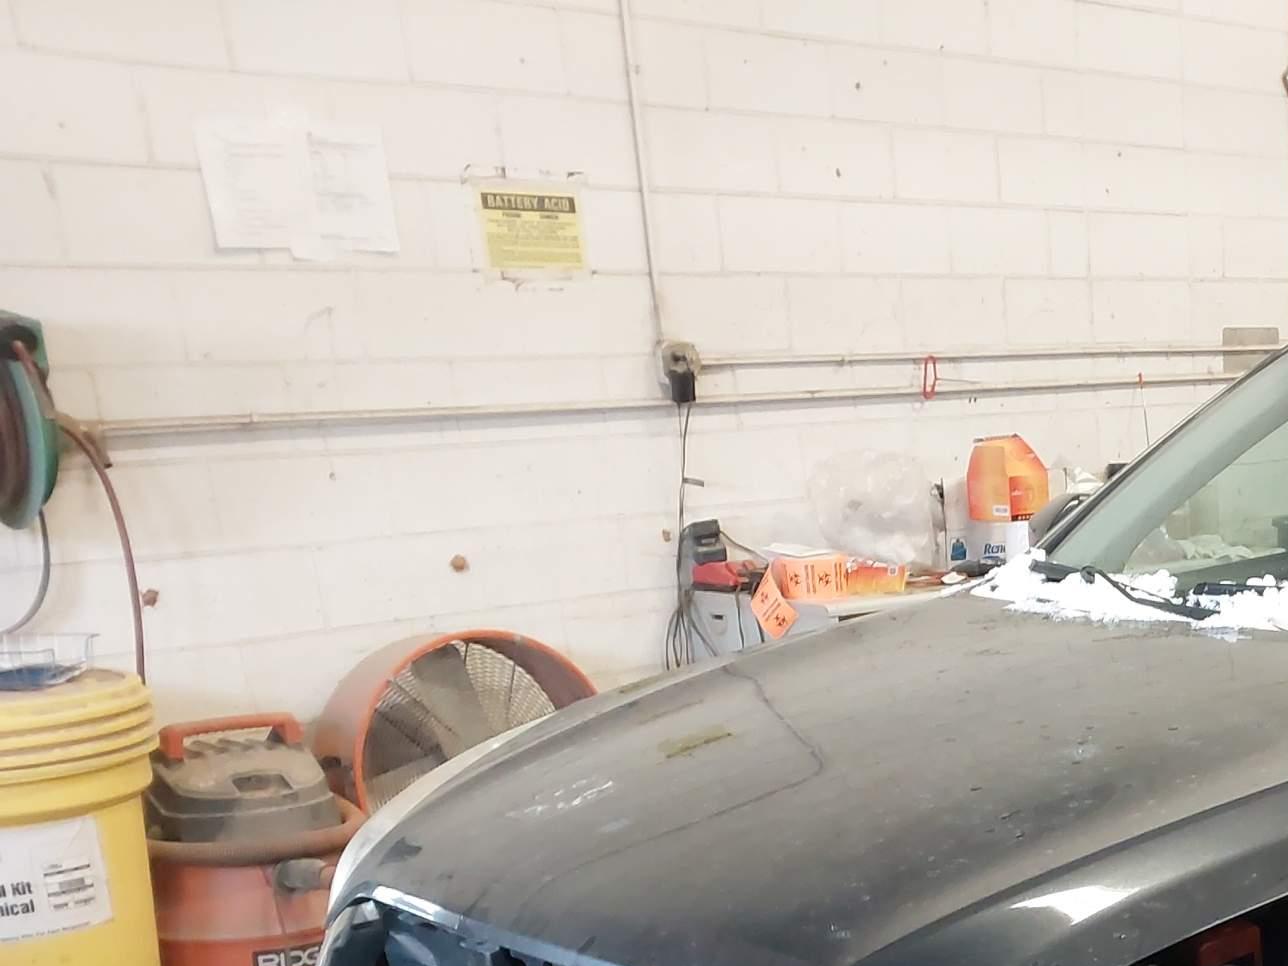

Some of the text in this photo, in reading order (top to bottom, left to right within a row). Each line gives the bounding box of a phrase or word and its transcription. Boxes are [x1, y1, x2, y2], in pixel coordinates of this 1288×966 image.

[487, 194, 571, 211] BATTERY ACID
[10, 880, 33, 897] Kit
